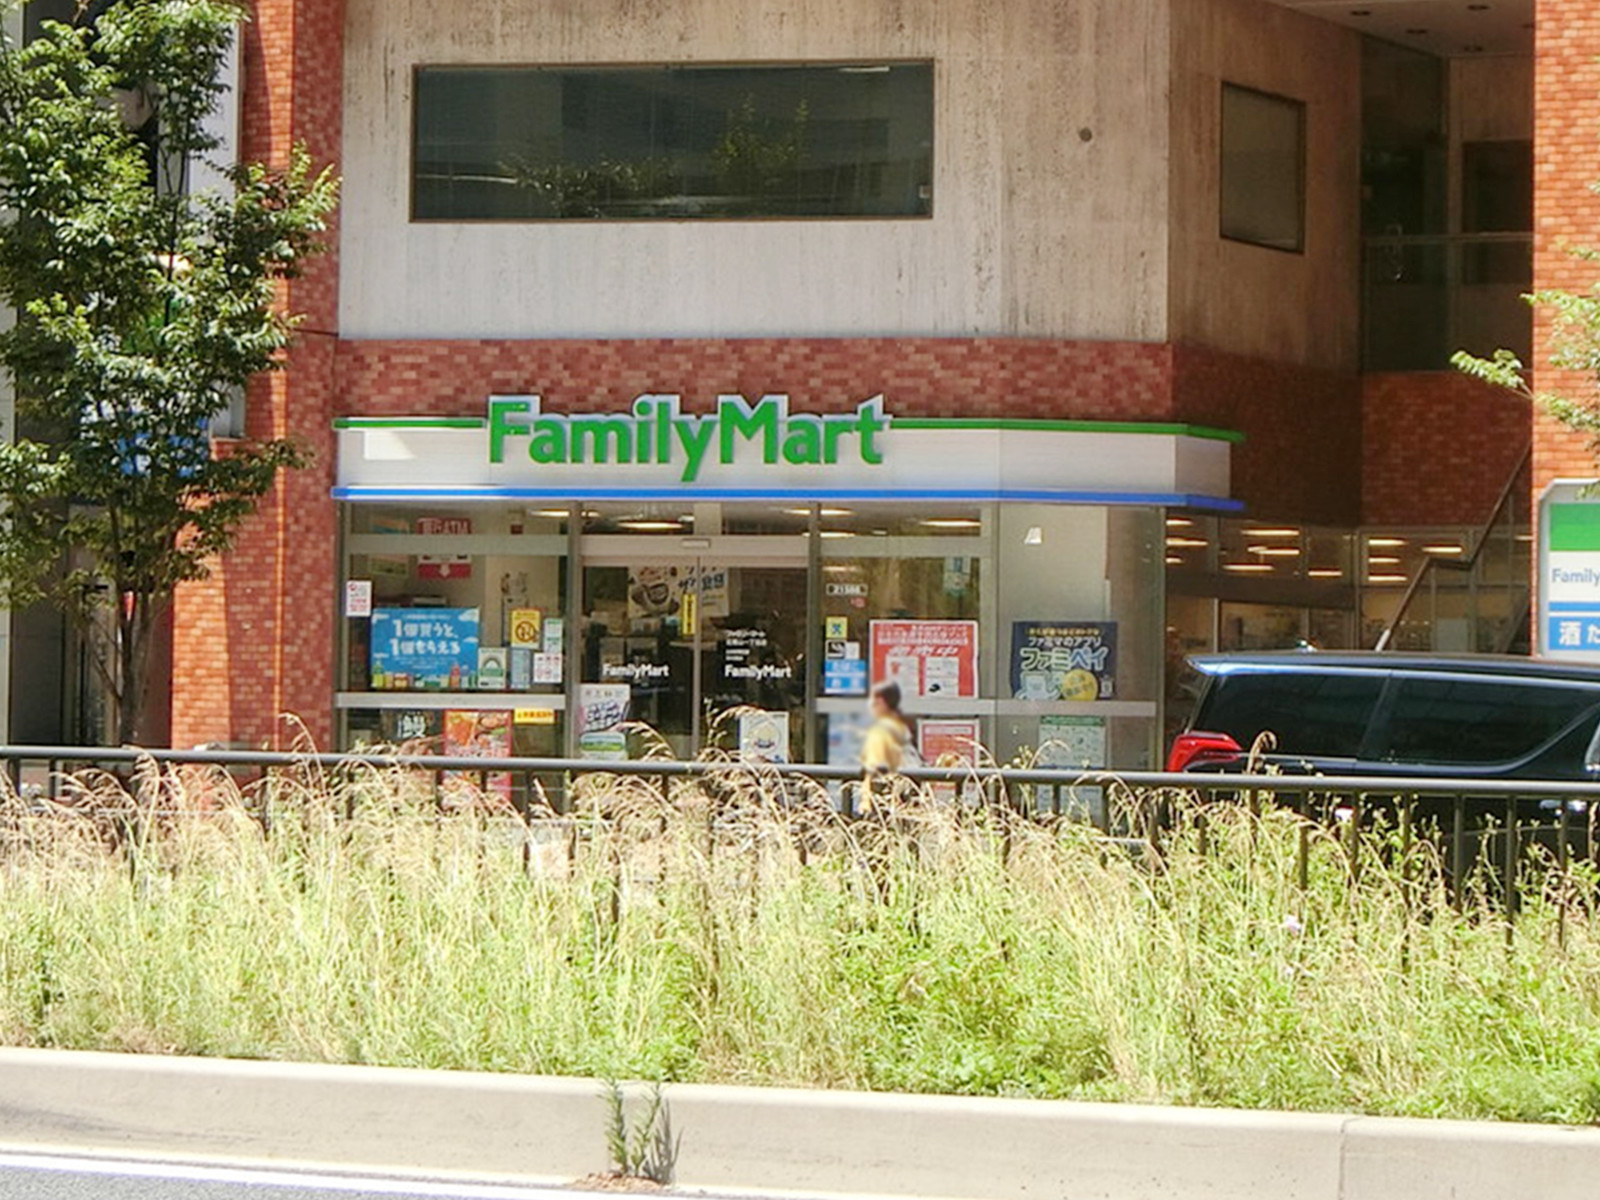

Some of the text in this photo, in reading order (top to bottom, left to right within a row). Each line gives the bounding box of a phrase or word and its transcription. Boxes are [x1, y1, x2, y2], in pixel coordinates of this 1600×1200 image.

[489, 396, 886, 482] FamilyMart
[1552, 568, 1600, 587] Family
[1559, 621, 1581, 646] 酒
[390, 637, 461, 656] 1個もらえる
[1020, 647, 1109, 671] ファミペイ
[602, 663, 669, 679] FamilyMart
[725, 664, 792, 680] FamilyMart
